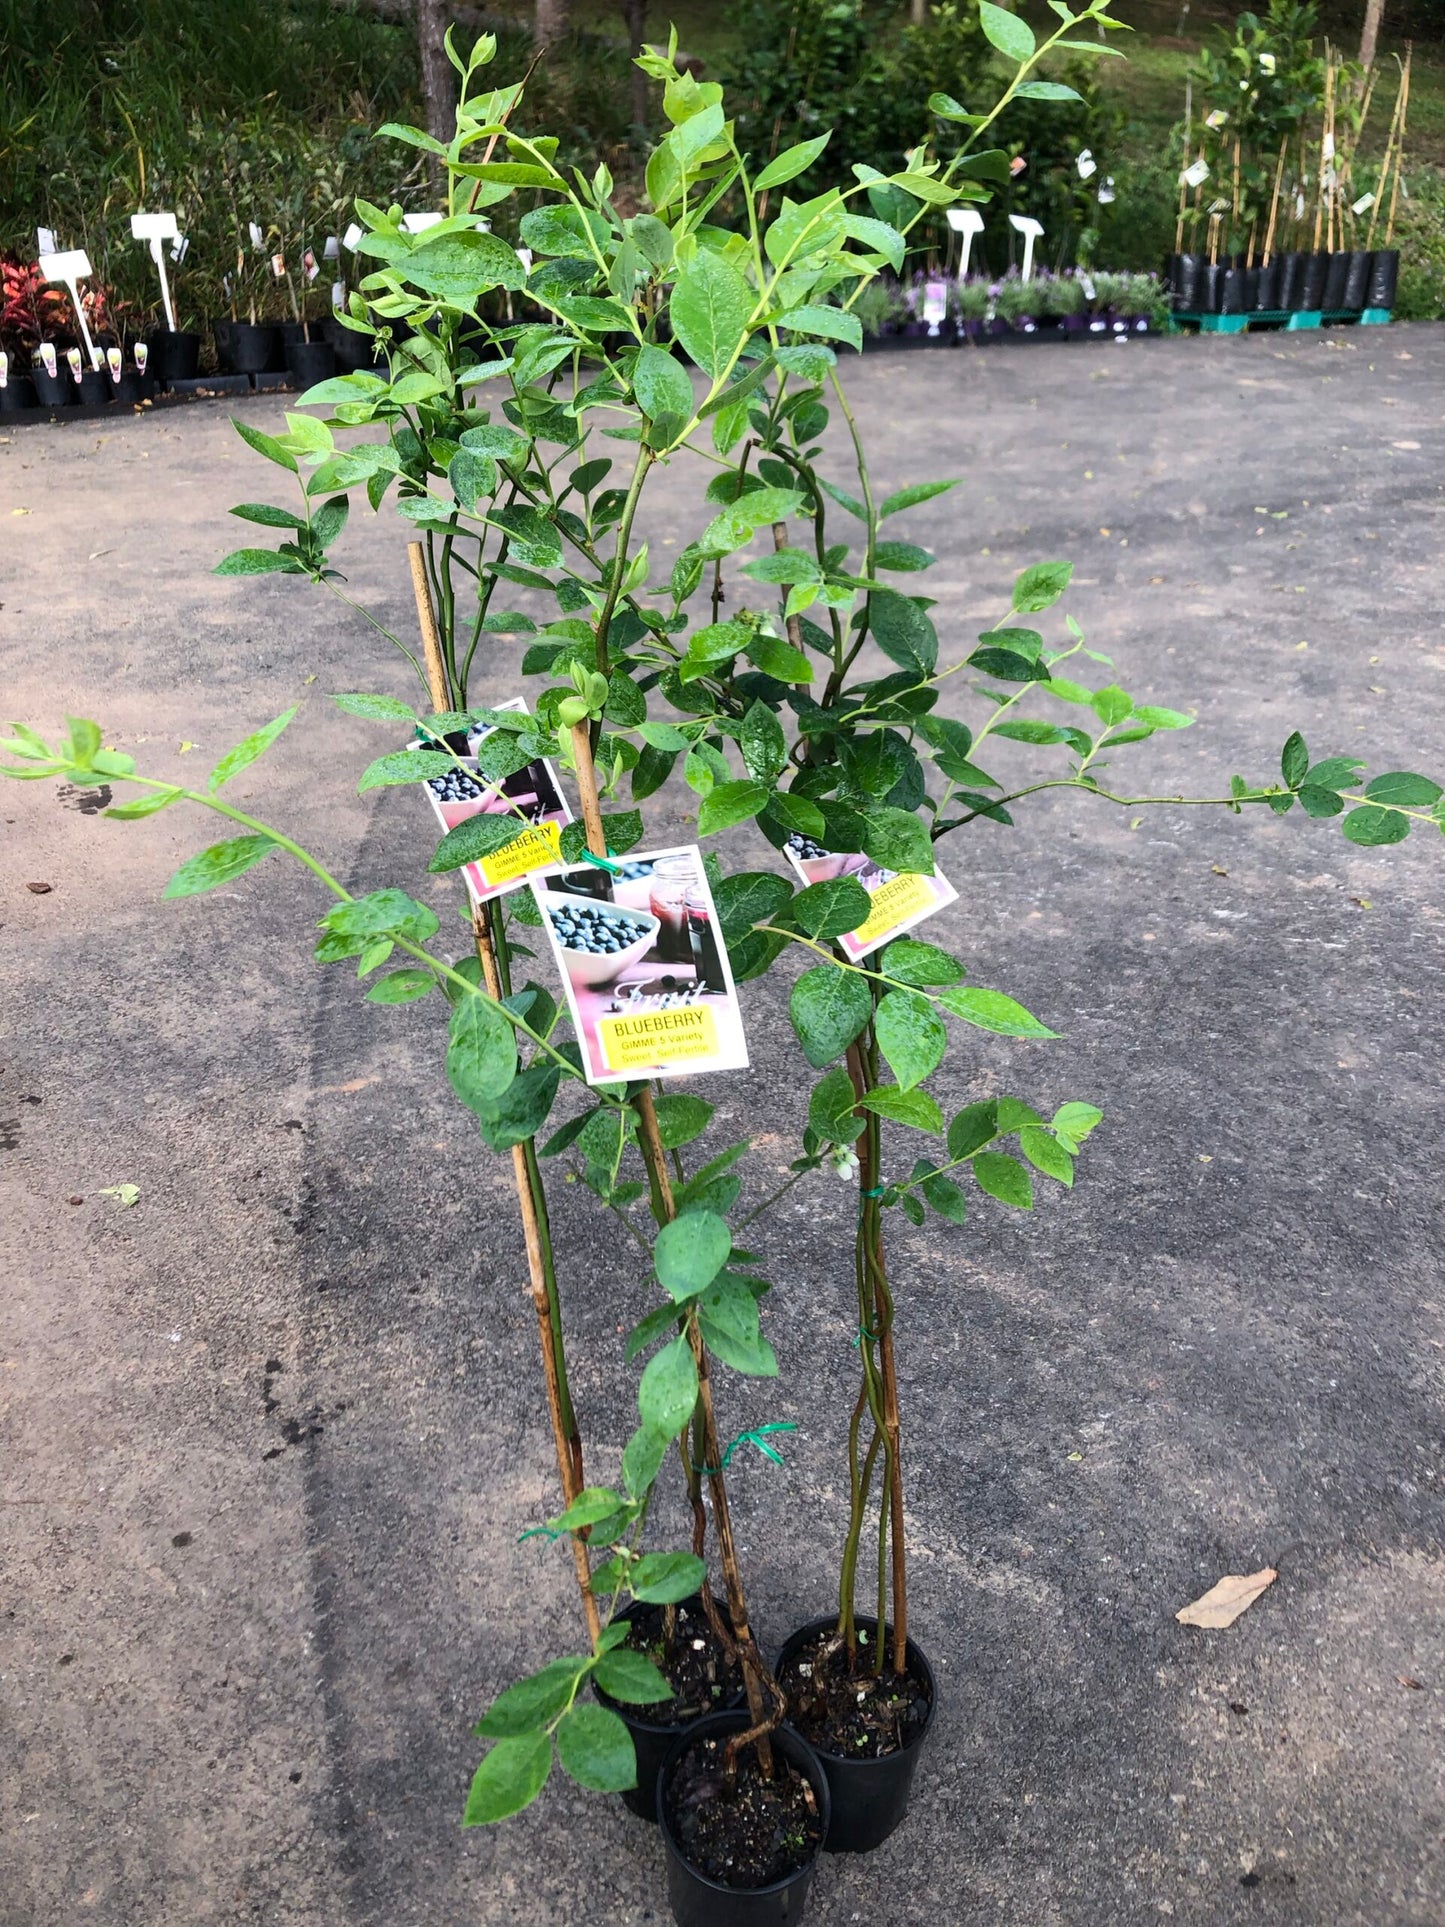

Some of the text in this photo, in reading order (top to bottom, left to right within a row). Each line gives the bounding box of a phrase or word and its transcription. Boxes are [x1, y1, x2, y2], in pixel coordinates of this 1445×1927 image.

[870, 874, 915, 909] UEBERRY
[614, 1011, 703, 1037] BLUEBERRY
[621, 1032, 703, 1051] GIMME 5 Variety
